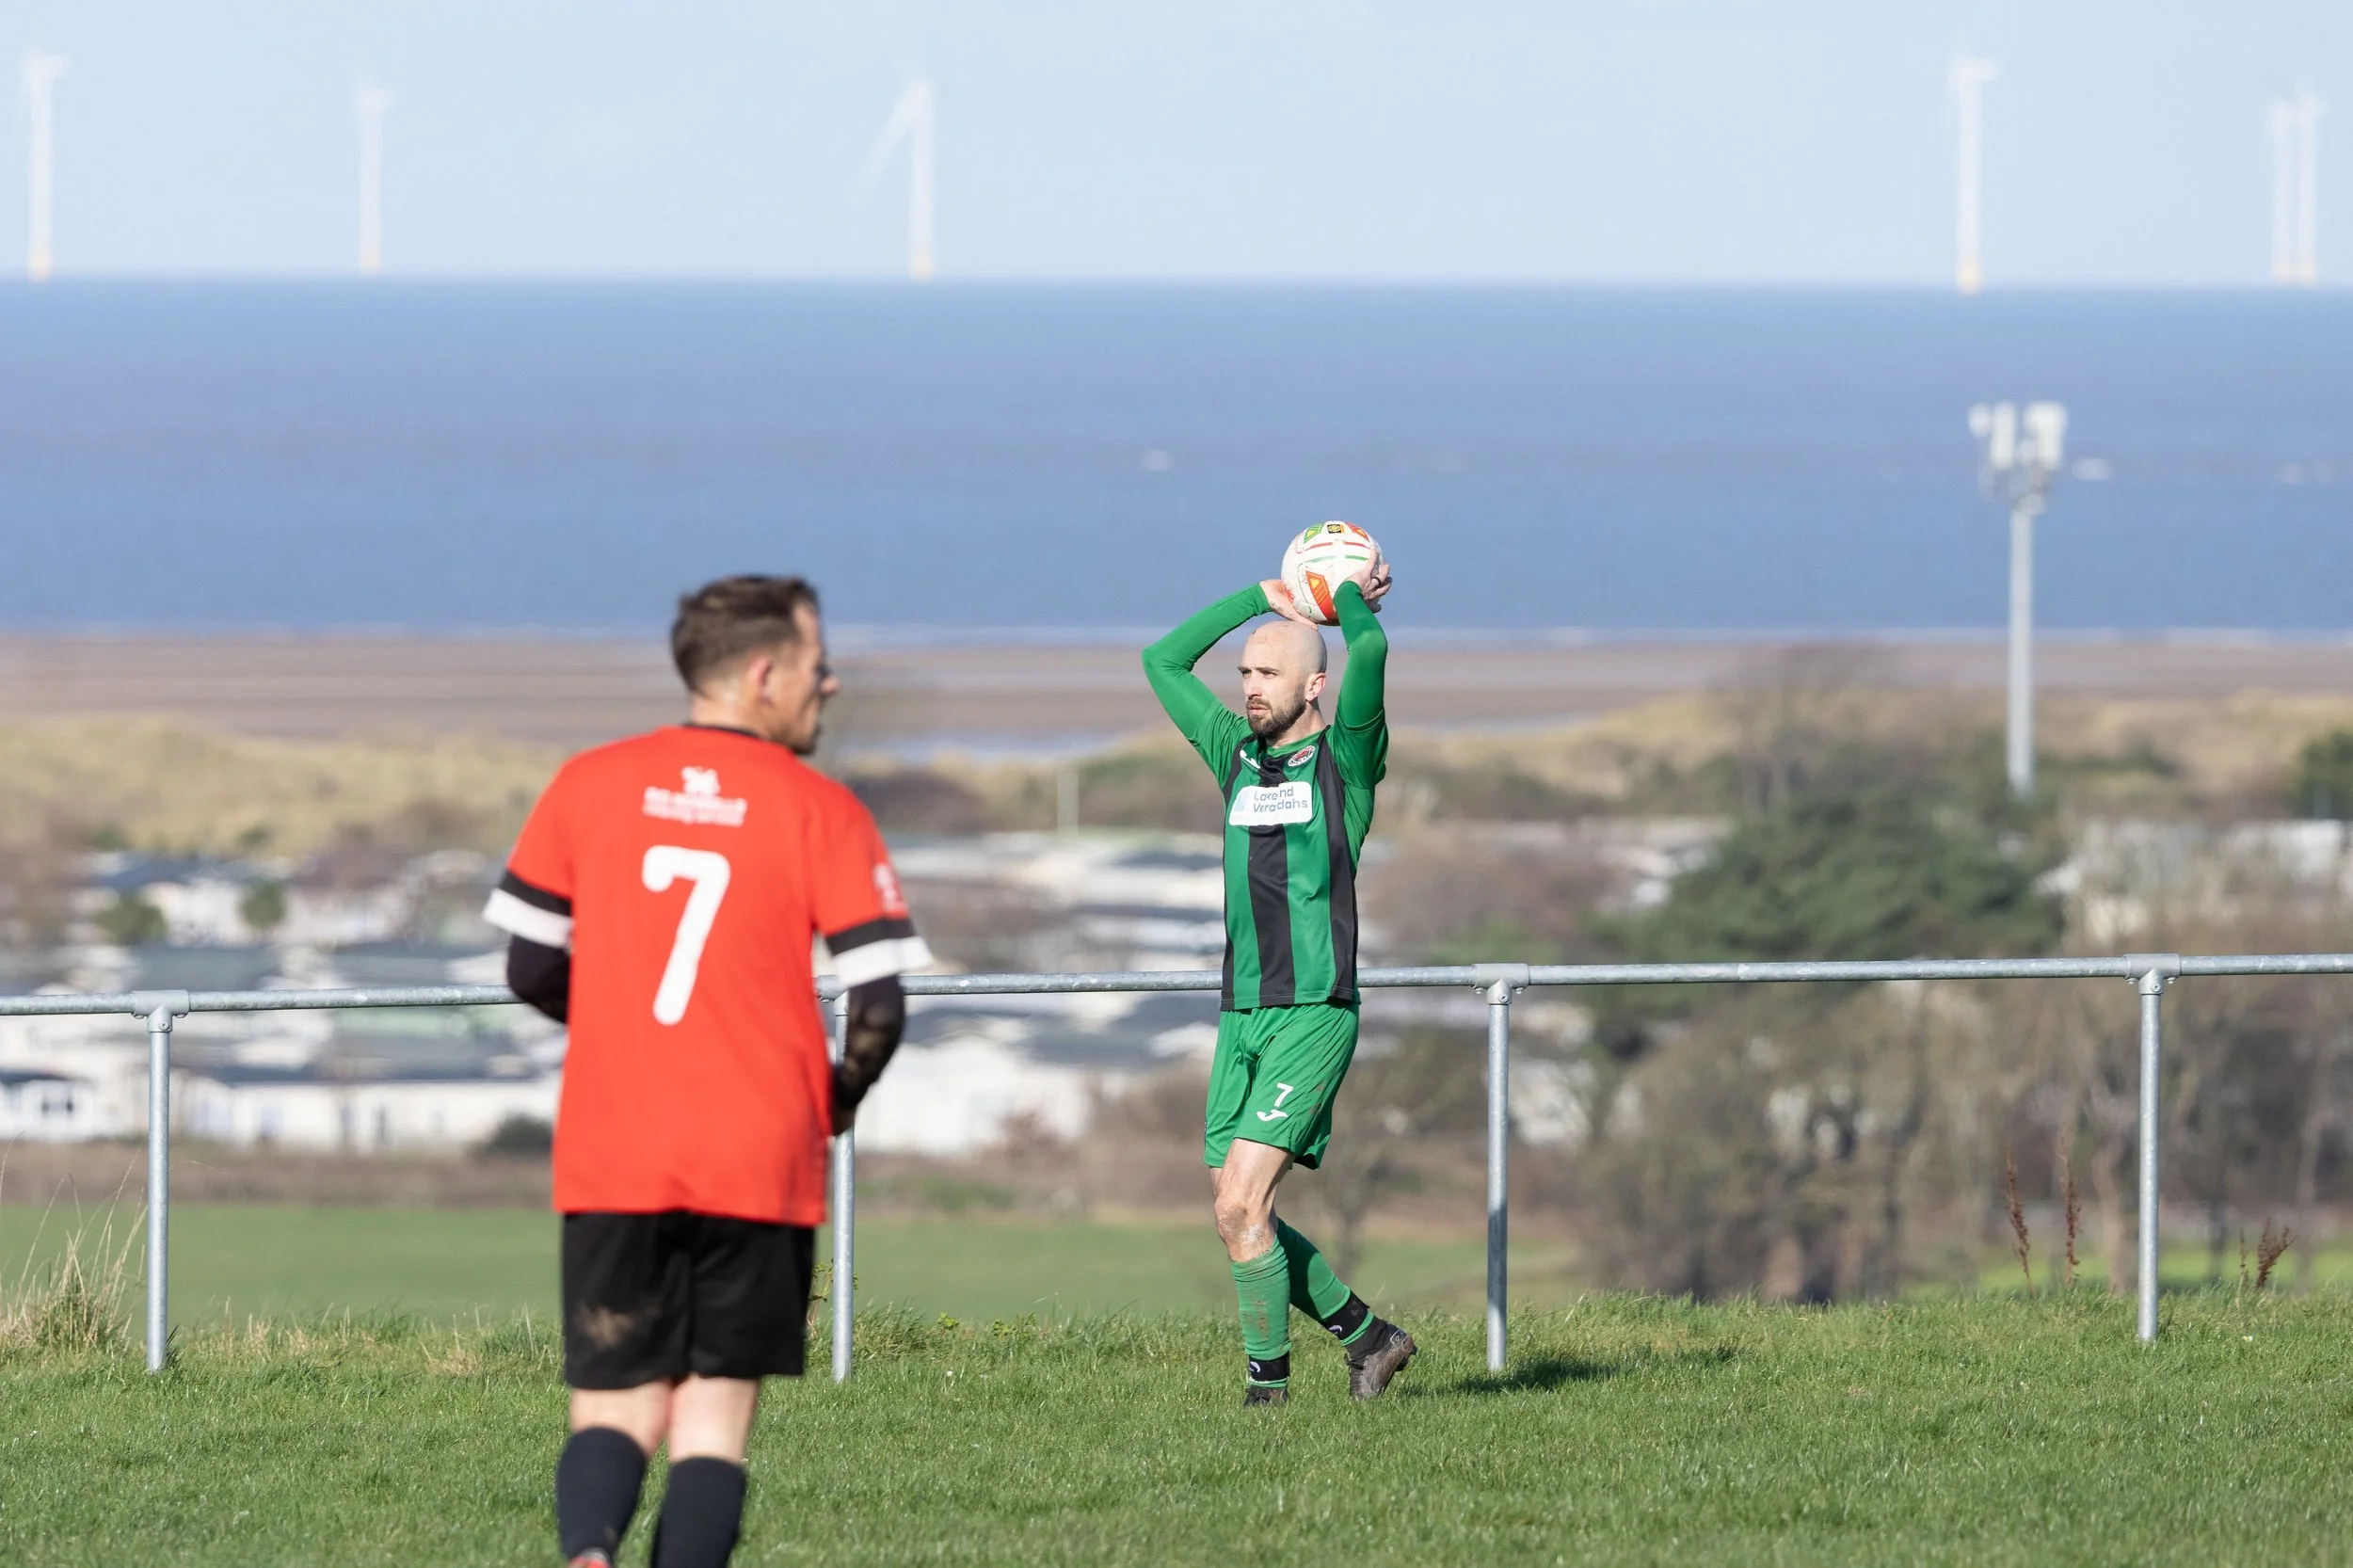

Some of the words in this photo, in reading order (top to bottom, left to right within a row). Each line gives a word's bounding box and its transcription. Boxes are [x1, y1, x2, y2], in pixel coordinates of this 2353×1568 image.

[1253, 798, 1308, 813] Veradahs
[642, 845, 730, 1026] 7
[1273, 1082, 1294, 1108] 7
